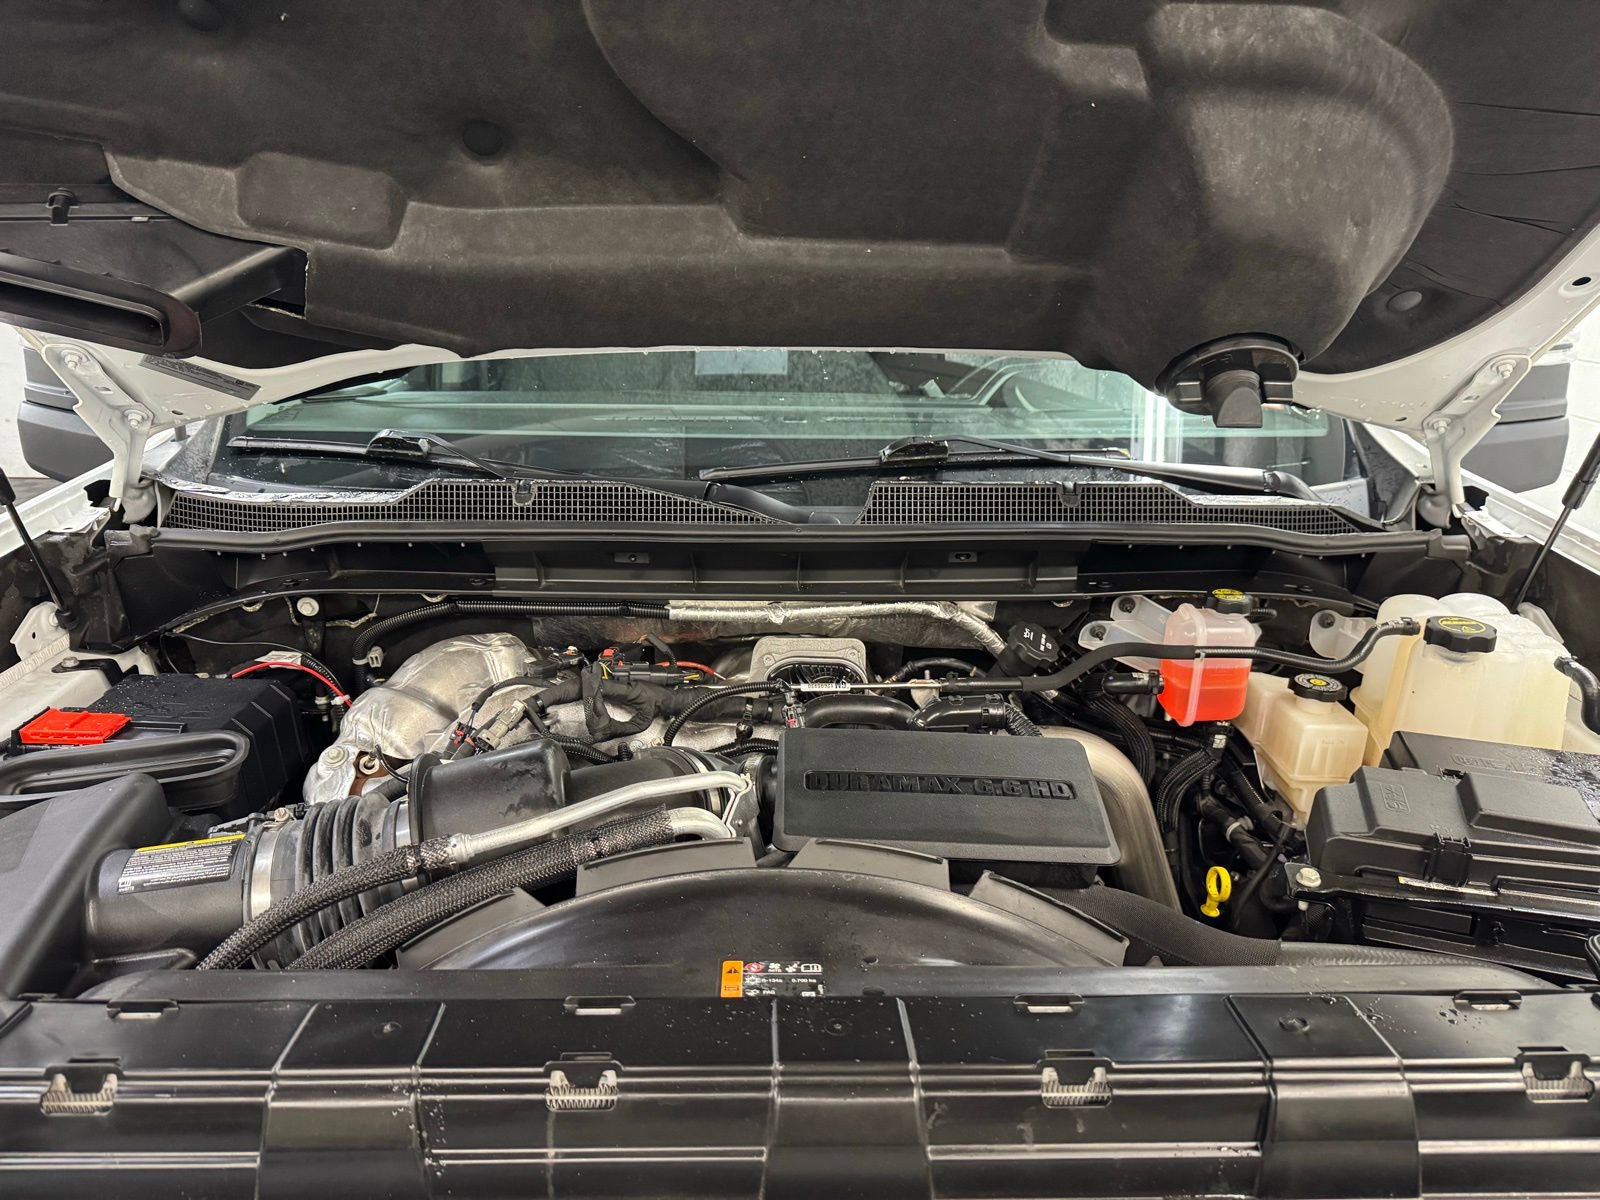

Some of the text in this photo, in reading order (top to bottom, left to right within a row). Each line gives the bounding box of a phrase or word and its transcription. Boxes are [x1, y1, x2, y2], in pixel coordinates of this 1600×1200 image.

[812, 772, 1073, 799] DURAMAX 6.6 HD
